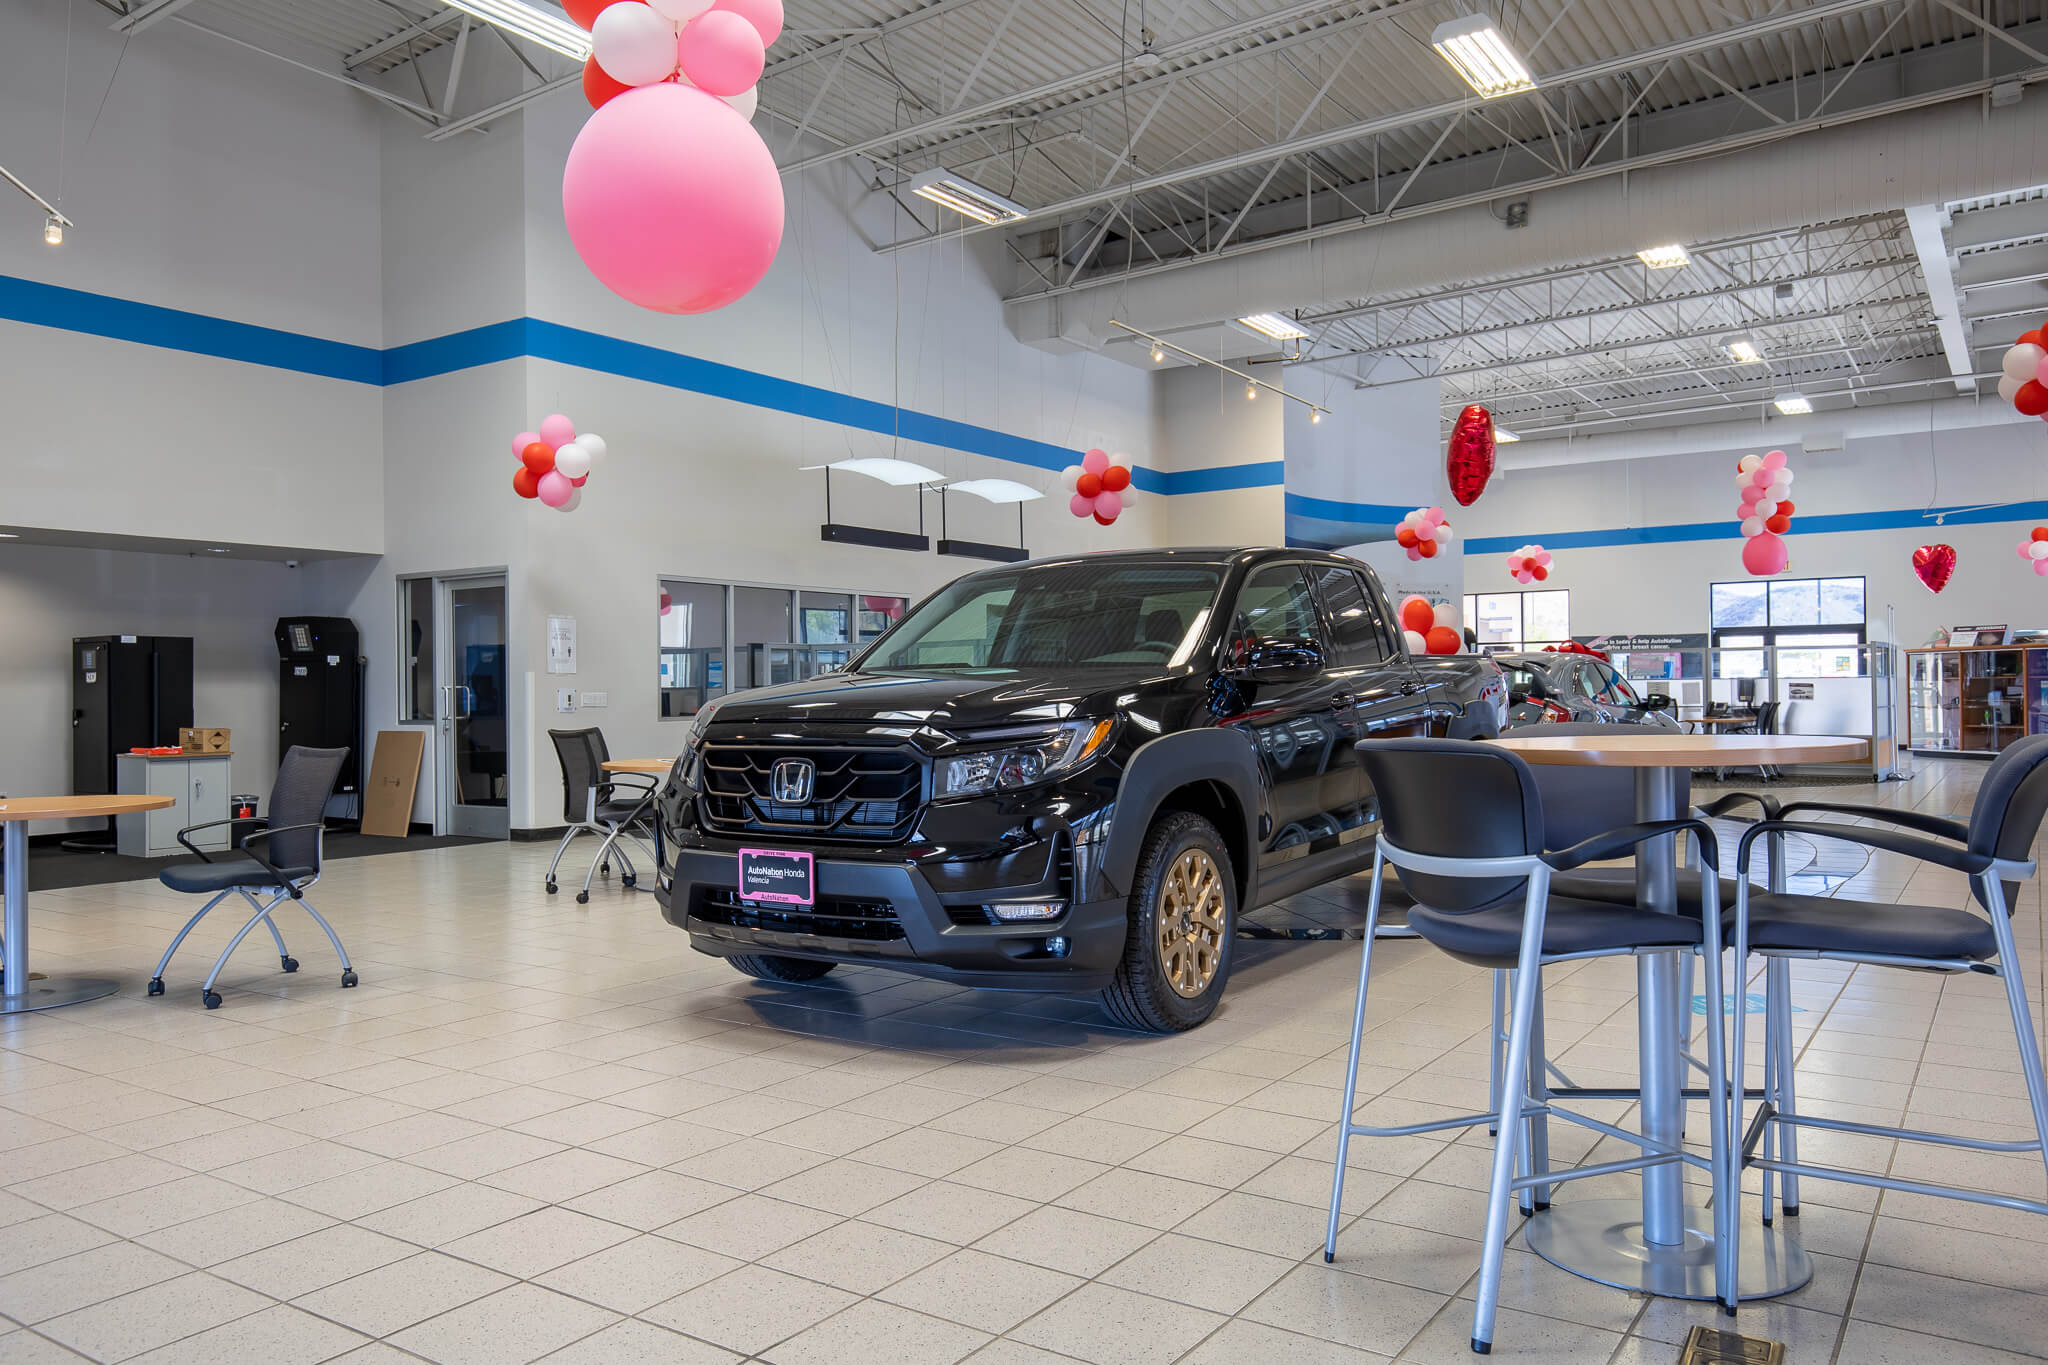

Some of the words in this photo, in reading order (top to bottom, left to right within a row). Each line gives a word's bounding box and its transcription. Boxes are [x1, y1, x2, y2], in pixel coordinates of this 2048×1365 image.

[748, 866, 784, 877] AutoNation
[784, 869, 805, 877] Honda
[747, 876, 770, 884] Valencia
